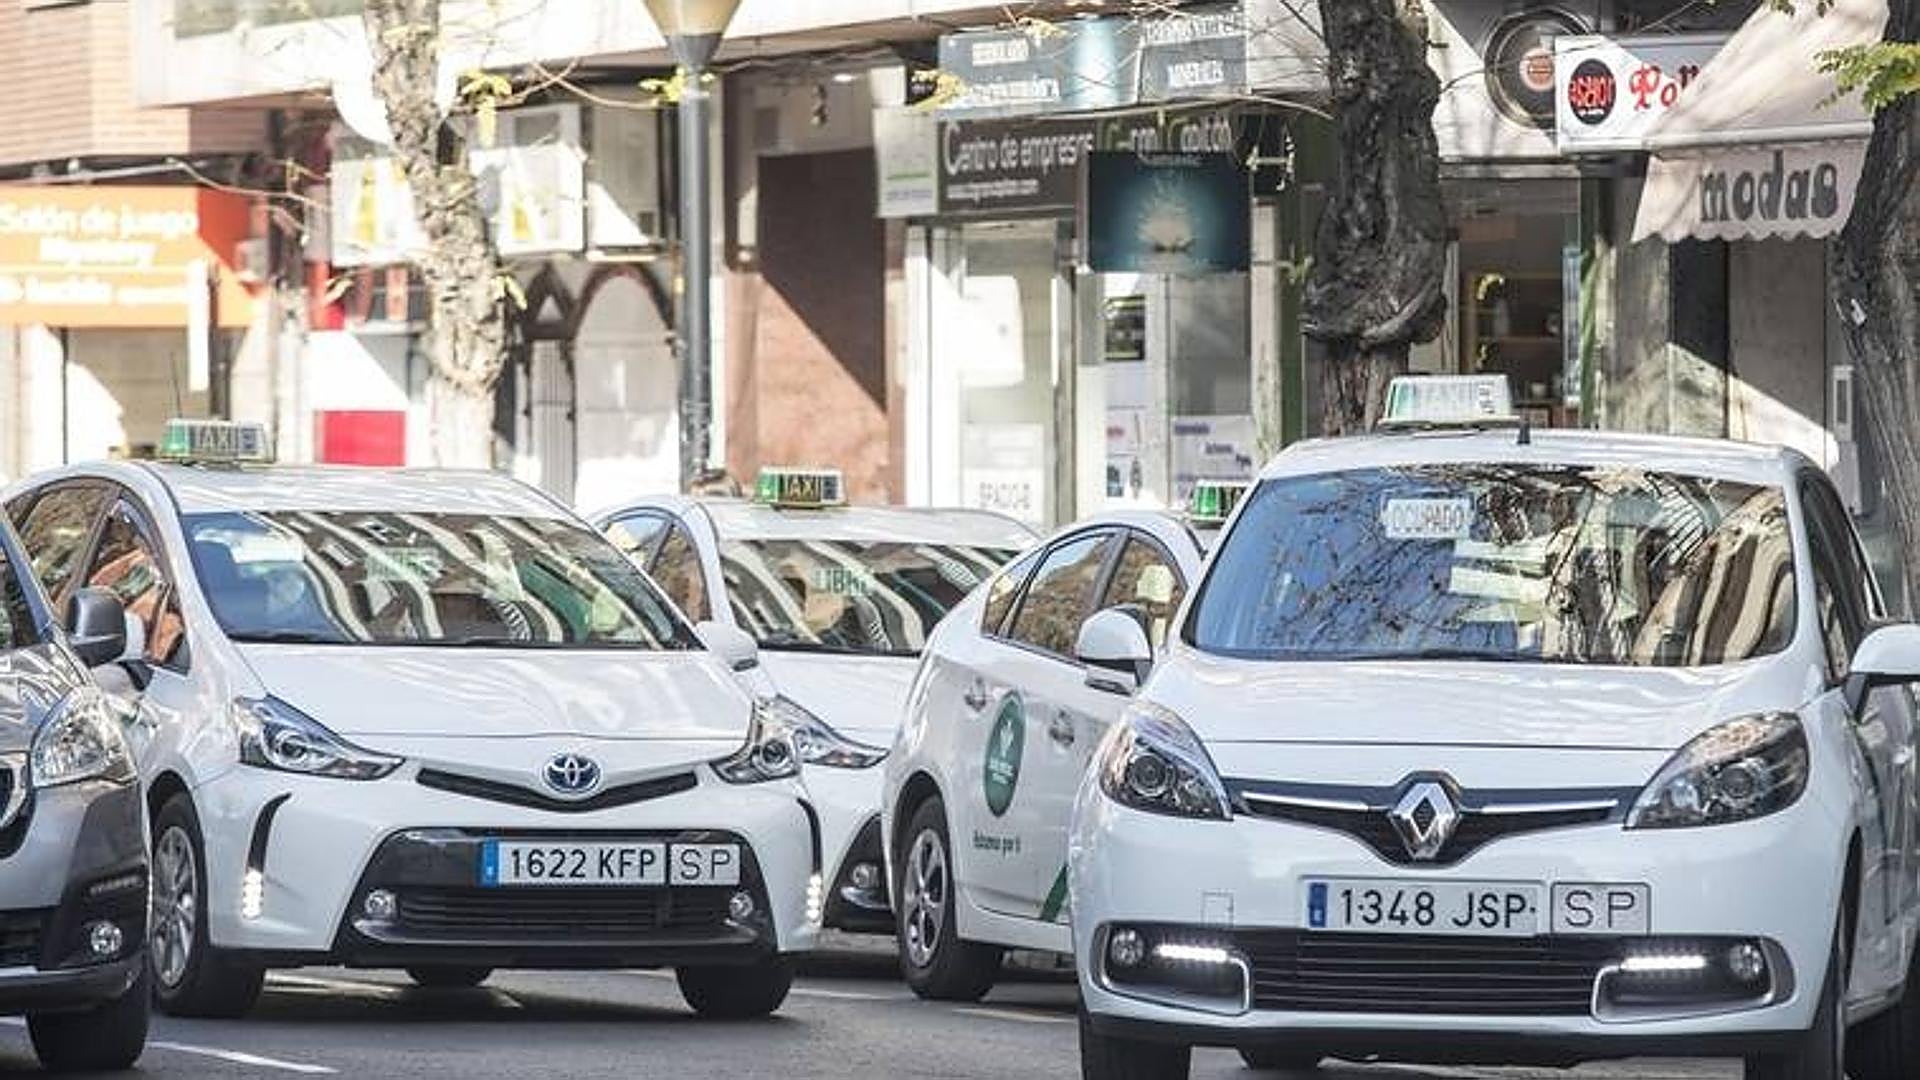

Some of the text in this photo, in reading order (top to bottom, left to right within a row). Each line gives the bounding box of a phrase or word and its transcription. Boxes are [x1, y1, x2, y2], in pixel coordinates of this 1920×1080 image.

[943, 119, 998, 175] Centro
[1000, 132, 1018, 168] de
[1701, 149, 1838, 222] modas
[191, 425, 238, 455] TAXI
[780, 473, 820, 501] TAXI
[1389, 503, 1465, 533] OCUPADO
[511, 848, 656, 879] 1622 KFP
[1341, 889, 1529, 928] 1348 JSP
